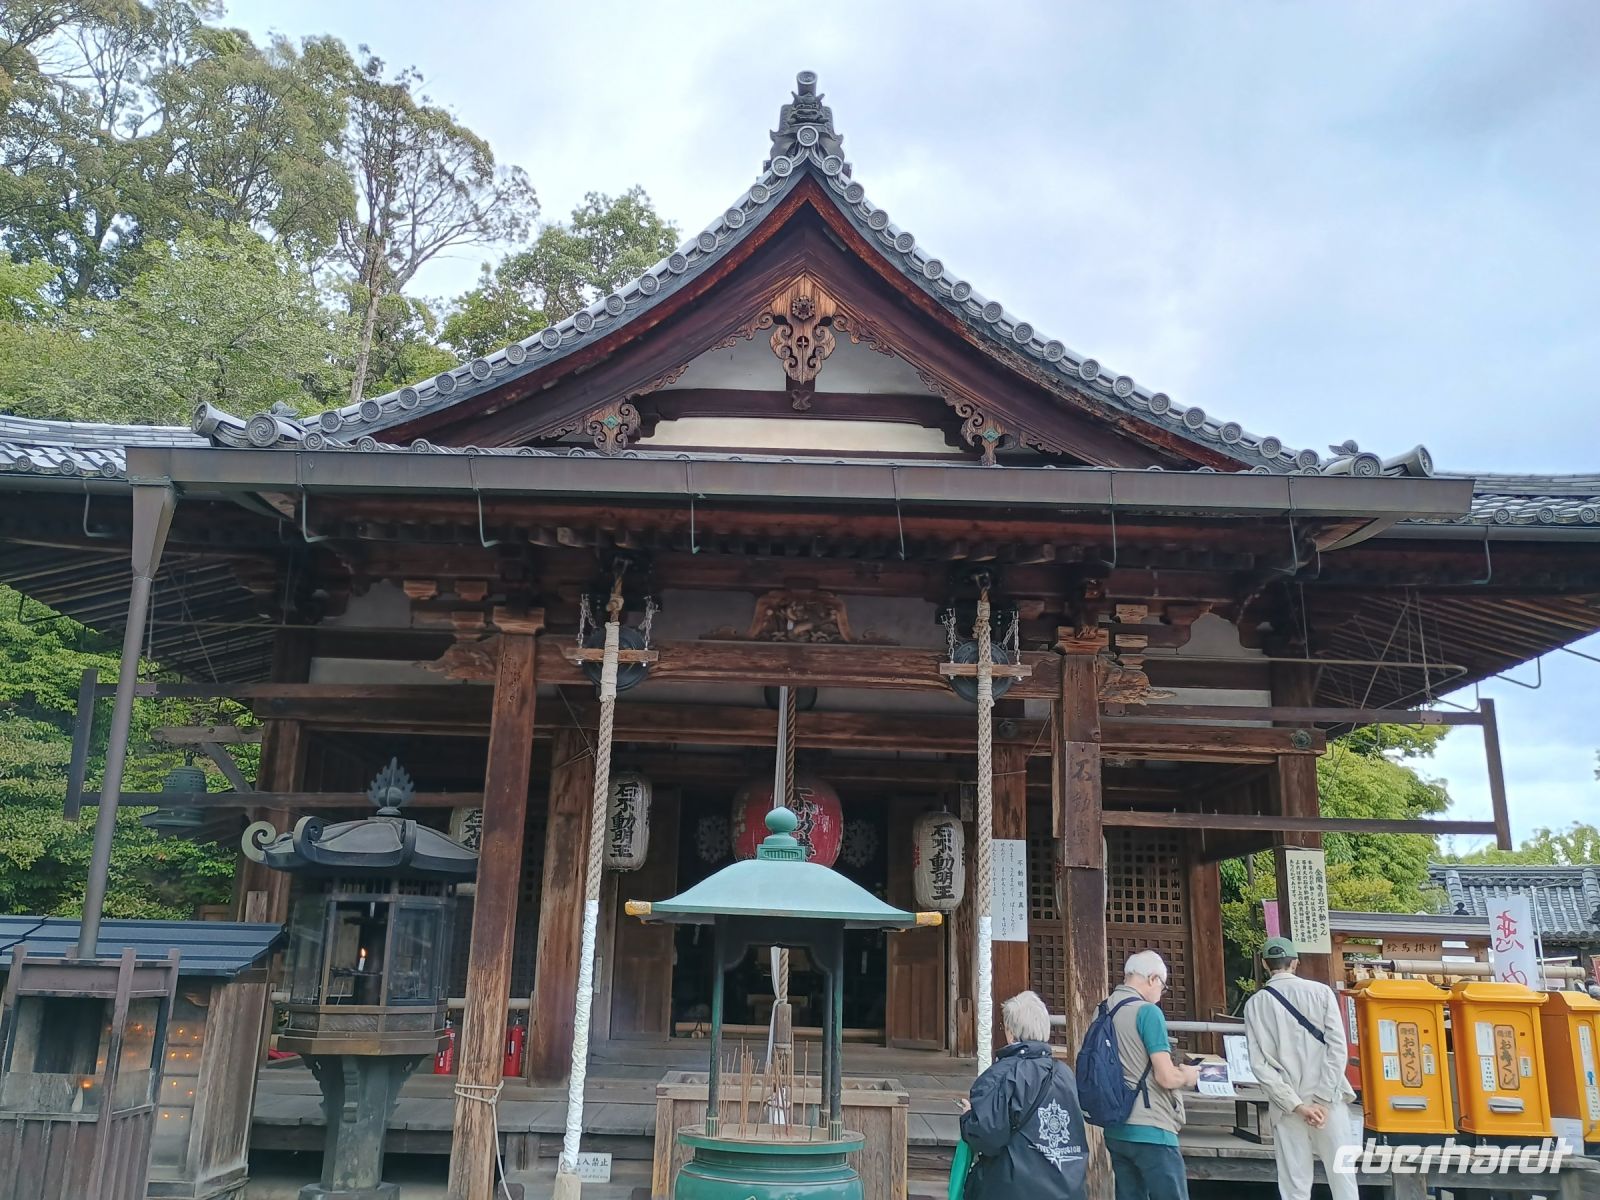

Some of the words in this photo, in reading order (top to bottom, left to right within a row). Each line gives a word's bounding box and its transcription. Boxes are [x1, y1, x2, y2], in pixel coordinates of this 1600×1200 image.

[609, 781, 639, 858] 石不動明王
[928, 821, 955, 901] 石不動明王
[1315, 868, 1327, 936] 金閣寺のお不動さん
[1386, 943, 1436, 953] 絵馬掛け
